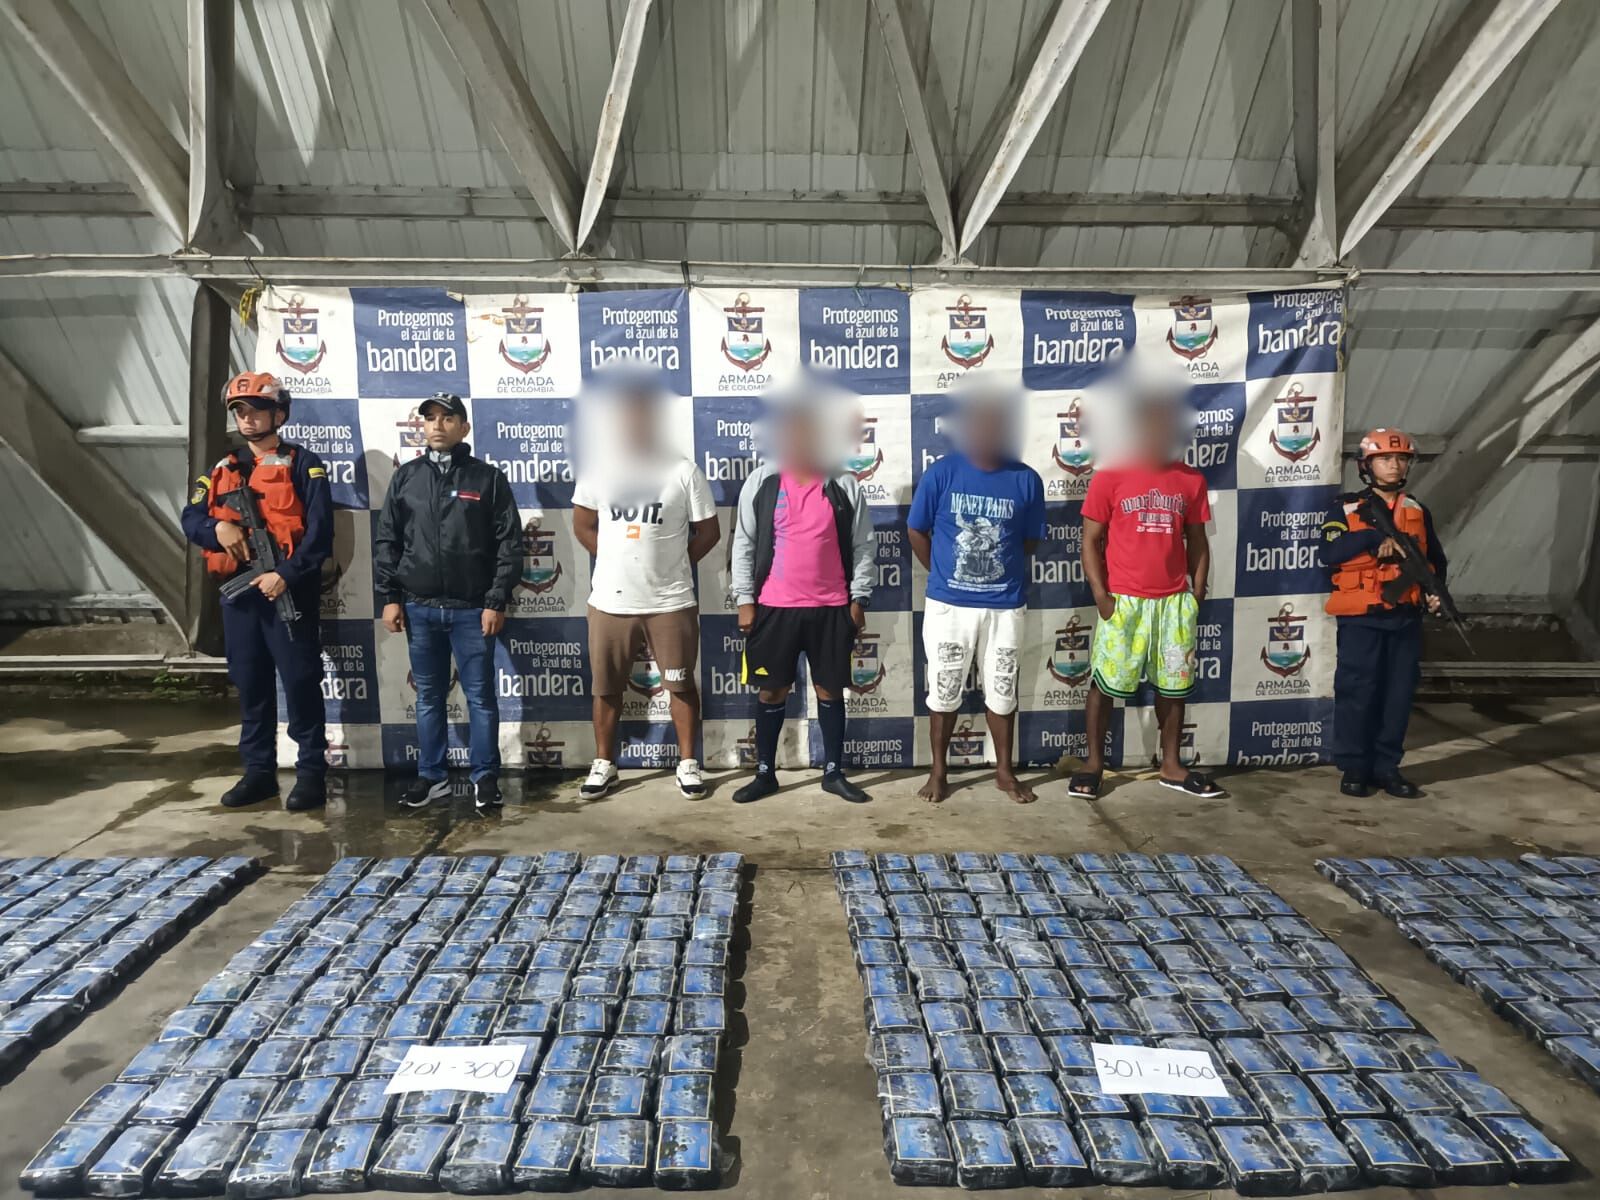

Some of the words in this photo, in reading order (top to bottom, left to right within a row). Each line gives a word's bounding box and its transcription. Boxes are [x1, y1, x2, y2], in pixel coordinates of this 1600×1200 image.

[602, 307, 678, 328] Protegemos
[822, 307, 899, 327] Protegemos
[1045, 308, 1122, 321] Protegemos
[1295, 308, 1304, 321] el
[1333, 300, 1343, 313] la
[377, 309, 454, 329] Protegemos
[1070, 320, 1079, 333] el
[1080, 319, 1100, 332] azul
[1101, 318, 1114, 331] de
[1115, 317, 1125, 330] la
[401, 328, 410, 341] el
[411, 328, 431, 341] azul
[432, 328, 444, 341] de
[446, 328, 455, 341] la
[625, 326, 634, 339] el
[635, 326, 655, 339] azul
[656, 326, 668, 339] de
[670, 325, 679, 339] la
[845, 325, 854, 339] el
[855, 325, 875, 338] azul
[876, 324, 888, 338] de
[890, 324, 899, 337] la
[1258, 318, 1341, 354] bandera
[810, 338, 899, 369] bandera
[1033, 332, 1124, 365] bandera
[366, 341, 457, 372] bandera
[497, 376, 555, 386] ARMADA
[277, 423, 352, 442] rotegemos
[497, 421, 564, 442] Protegemo
[717, 419, 753, 439] Prote
[1210, 424, 1223, 437] de
[1225, 422, 1234, 436] la
[309, 441, 330, 453] azul
[331, 441, 343, 453] de
[345, 441, 354, 453] la
[520, 440, 529, 453] el
[530, 440, 549, 453] azul
[550, 440, 563, 453] de
[738, 438, 748, 451] el
[1184, 438, 1229, 468] dera
[705, 451, 764, 481] band
[1265, 464, 1321, 476] ARMADA
[1264, 475, 1275, 483] DE
[1278, 474, 1321, 482] COLOMBIA
[1260, 510, 1328, 530] Protegemo
[1280, 528, 1289, 540] el
[1290, 527, 1309, 540] azul
[1310, 526, 1322, 539] de
[879, 545, 891, 558] de
[892, 545, 901, 558] la
[1066, 541, 1075, 554] el
[1031, 554, 1088, 583] band
[521, 605, 566, 613] COLOMBIA
[509, 638, 581, 658] Protegemos
[1199, 639, 1211, 651] de
[1212, 638, 1221, 650] la
[343, 660, 355, 672] de
[356, 660, 365, 672] la
[532, 656, 541, 668] el
[541, 656, 560, 668] azul
[561, 656, 571, 669] de
[573, 656, 582, 669] la
[498, 668, 584, 697] bandera
[664, 668, 686, 682] NIKE
[320, 671, 367, 700] dera
[1256, 679, 1311, 689] ARMADA
[1044, 690, 1089, 699] ARMAD
[1268, 688, 1311, 696] COLOMBIA
[623, 701, 672, 710] ARMAD
[844, 697, 888, 707] RMADA
[1251, 721, 1322, 738] Protegemos
[1041, 730, 1113, 748] Proteges
[1271, 737, 1280, 748] el
[1281, 736, 1300, 748] azul
[1301, 735, 1312, 747] de
[1313, 735, 1322, 747] la
[620, 741, 681, 760] Protegem
[843, 739, 902, 756] otegemos
[852, 754, 860, 764] el
[862, 753, 880, 765] azul
[881, 752, 893, 764] de
[893, 751, 903, 763] la
